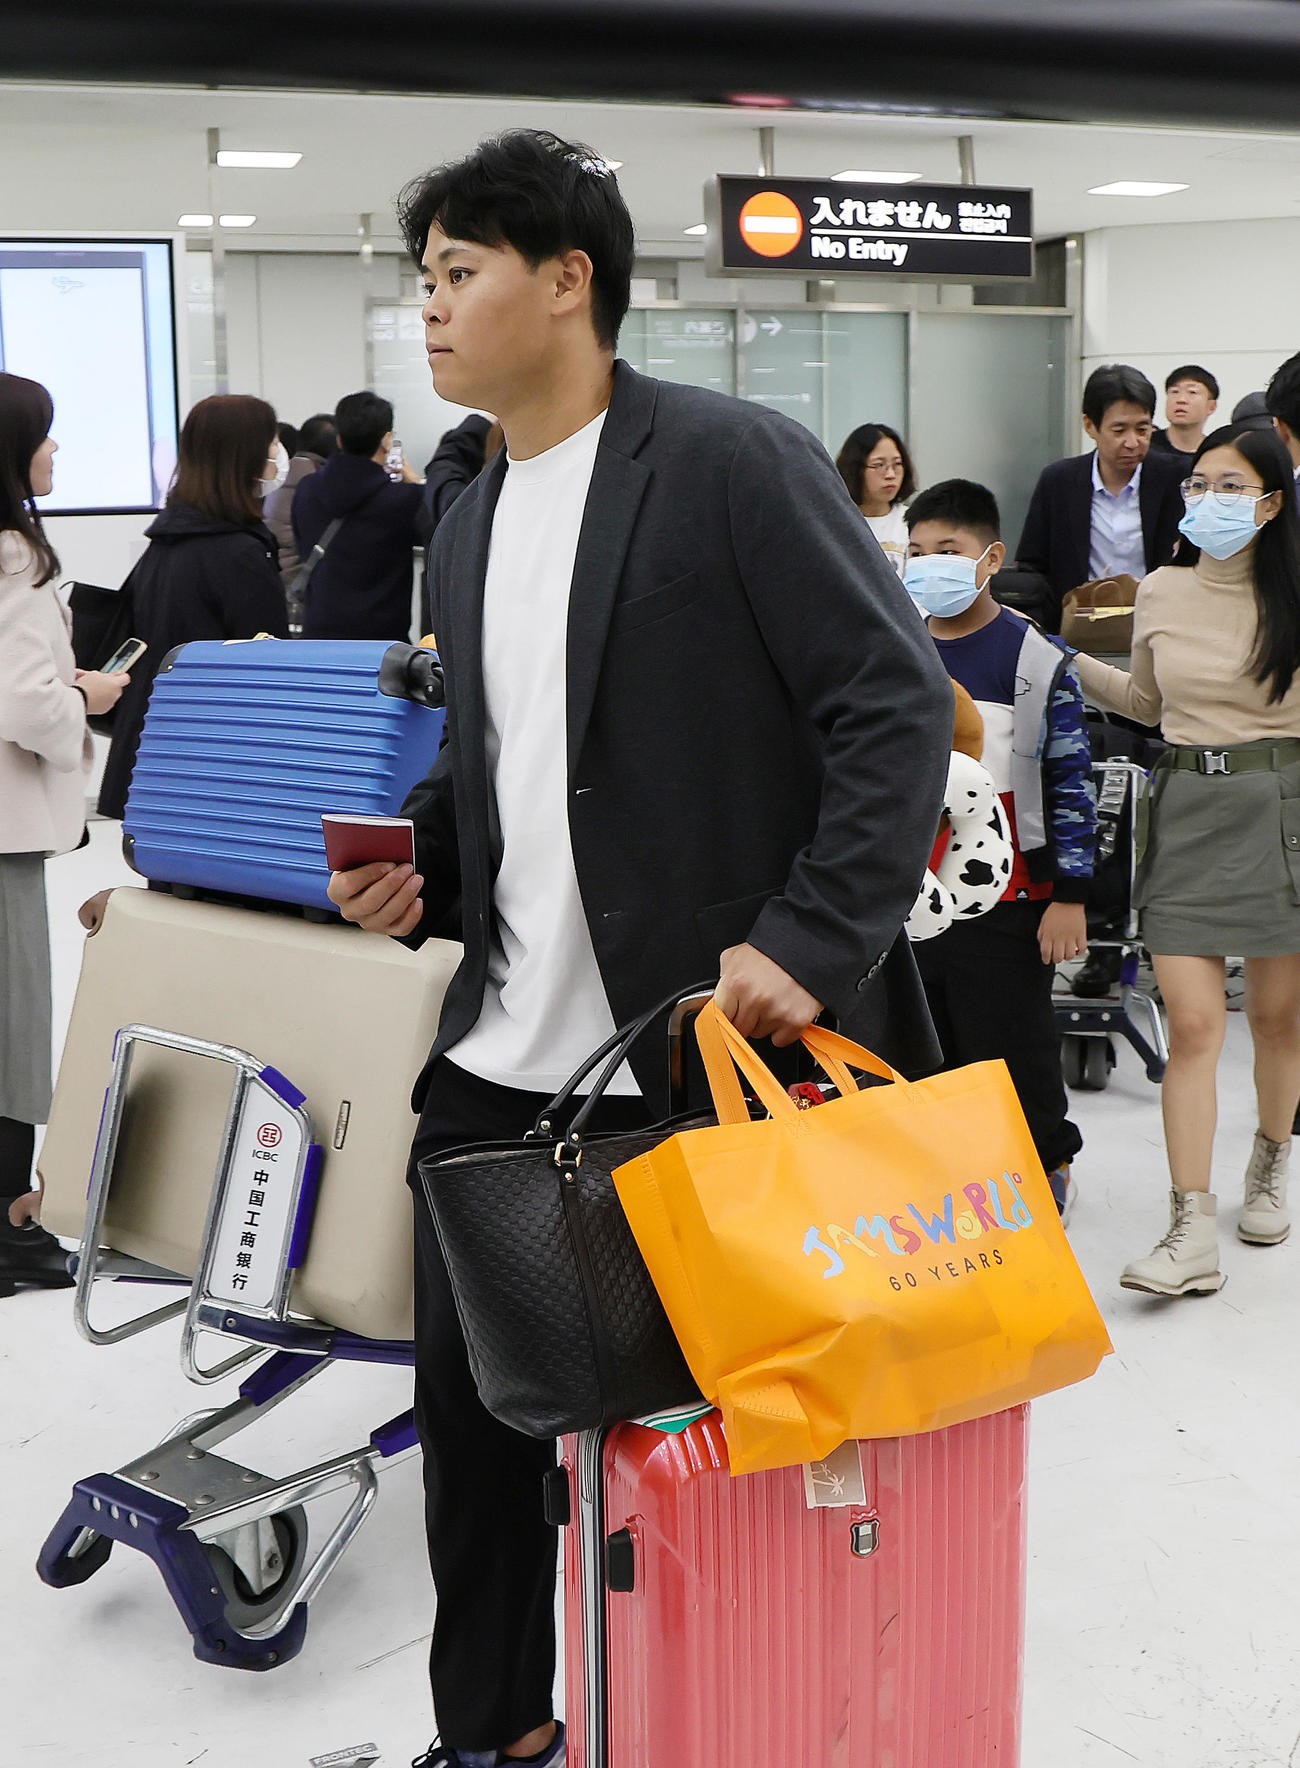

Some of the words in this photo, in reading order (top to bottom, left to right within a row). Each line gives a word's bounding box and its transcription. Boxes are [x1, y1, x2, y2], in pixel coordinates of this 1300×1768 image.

[809, 196, 952, 230] 入れません
[809, 235, 846, 258] No
[848, 237, 909, 266] Entry
[251, 1149, 279, 1162] ICBC
[232, 1169, 270, 1290] 中国工商银行
[889, 1272, 918, 1292] 60
[928, 1248, 1004, 1281] YEARS
